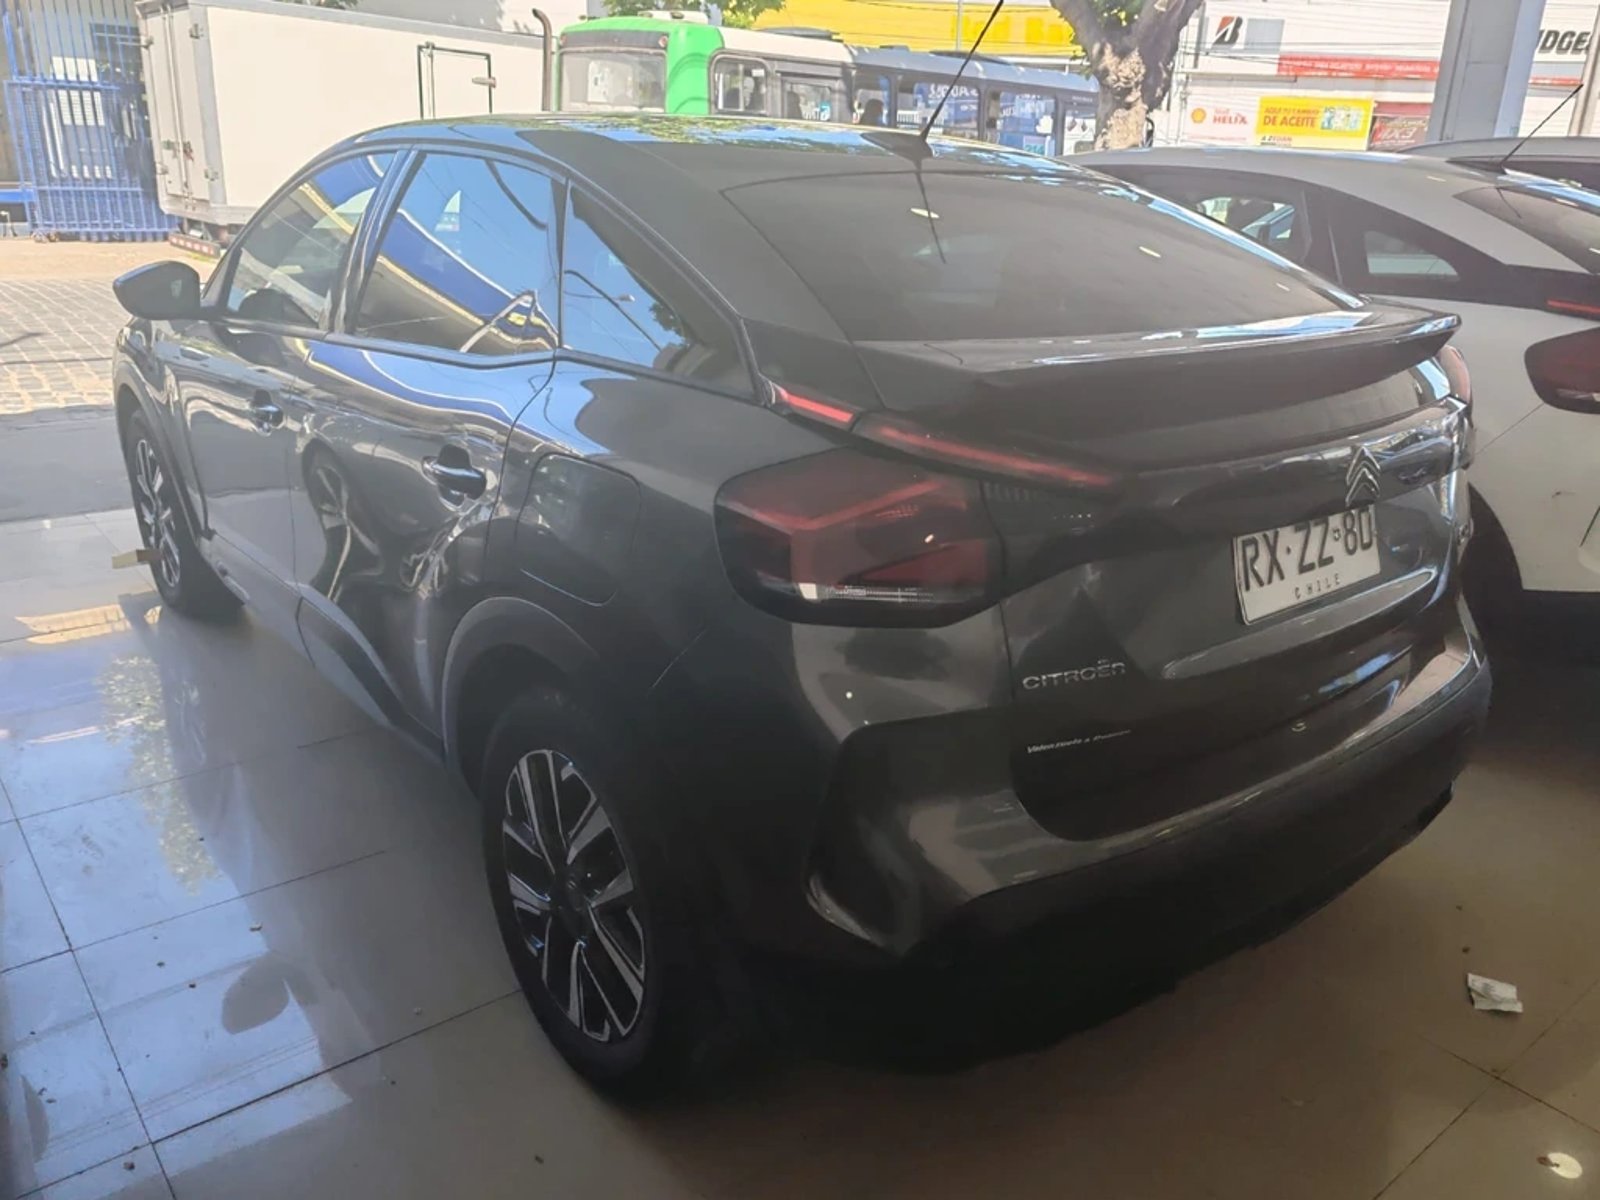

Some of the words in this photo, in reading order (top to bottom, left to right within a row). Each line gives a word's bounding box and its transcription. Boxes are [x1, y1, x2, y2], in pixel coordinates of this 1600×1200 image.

[1263, 115, 1278, 127] DE
[1279, 116, 1317, 129] ACEITE
[1294, 573, 1341, 600] CHILE
